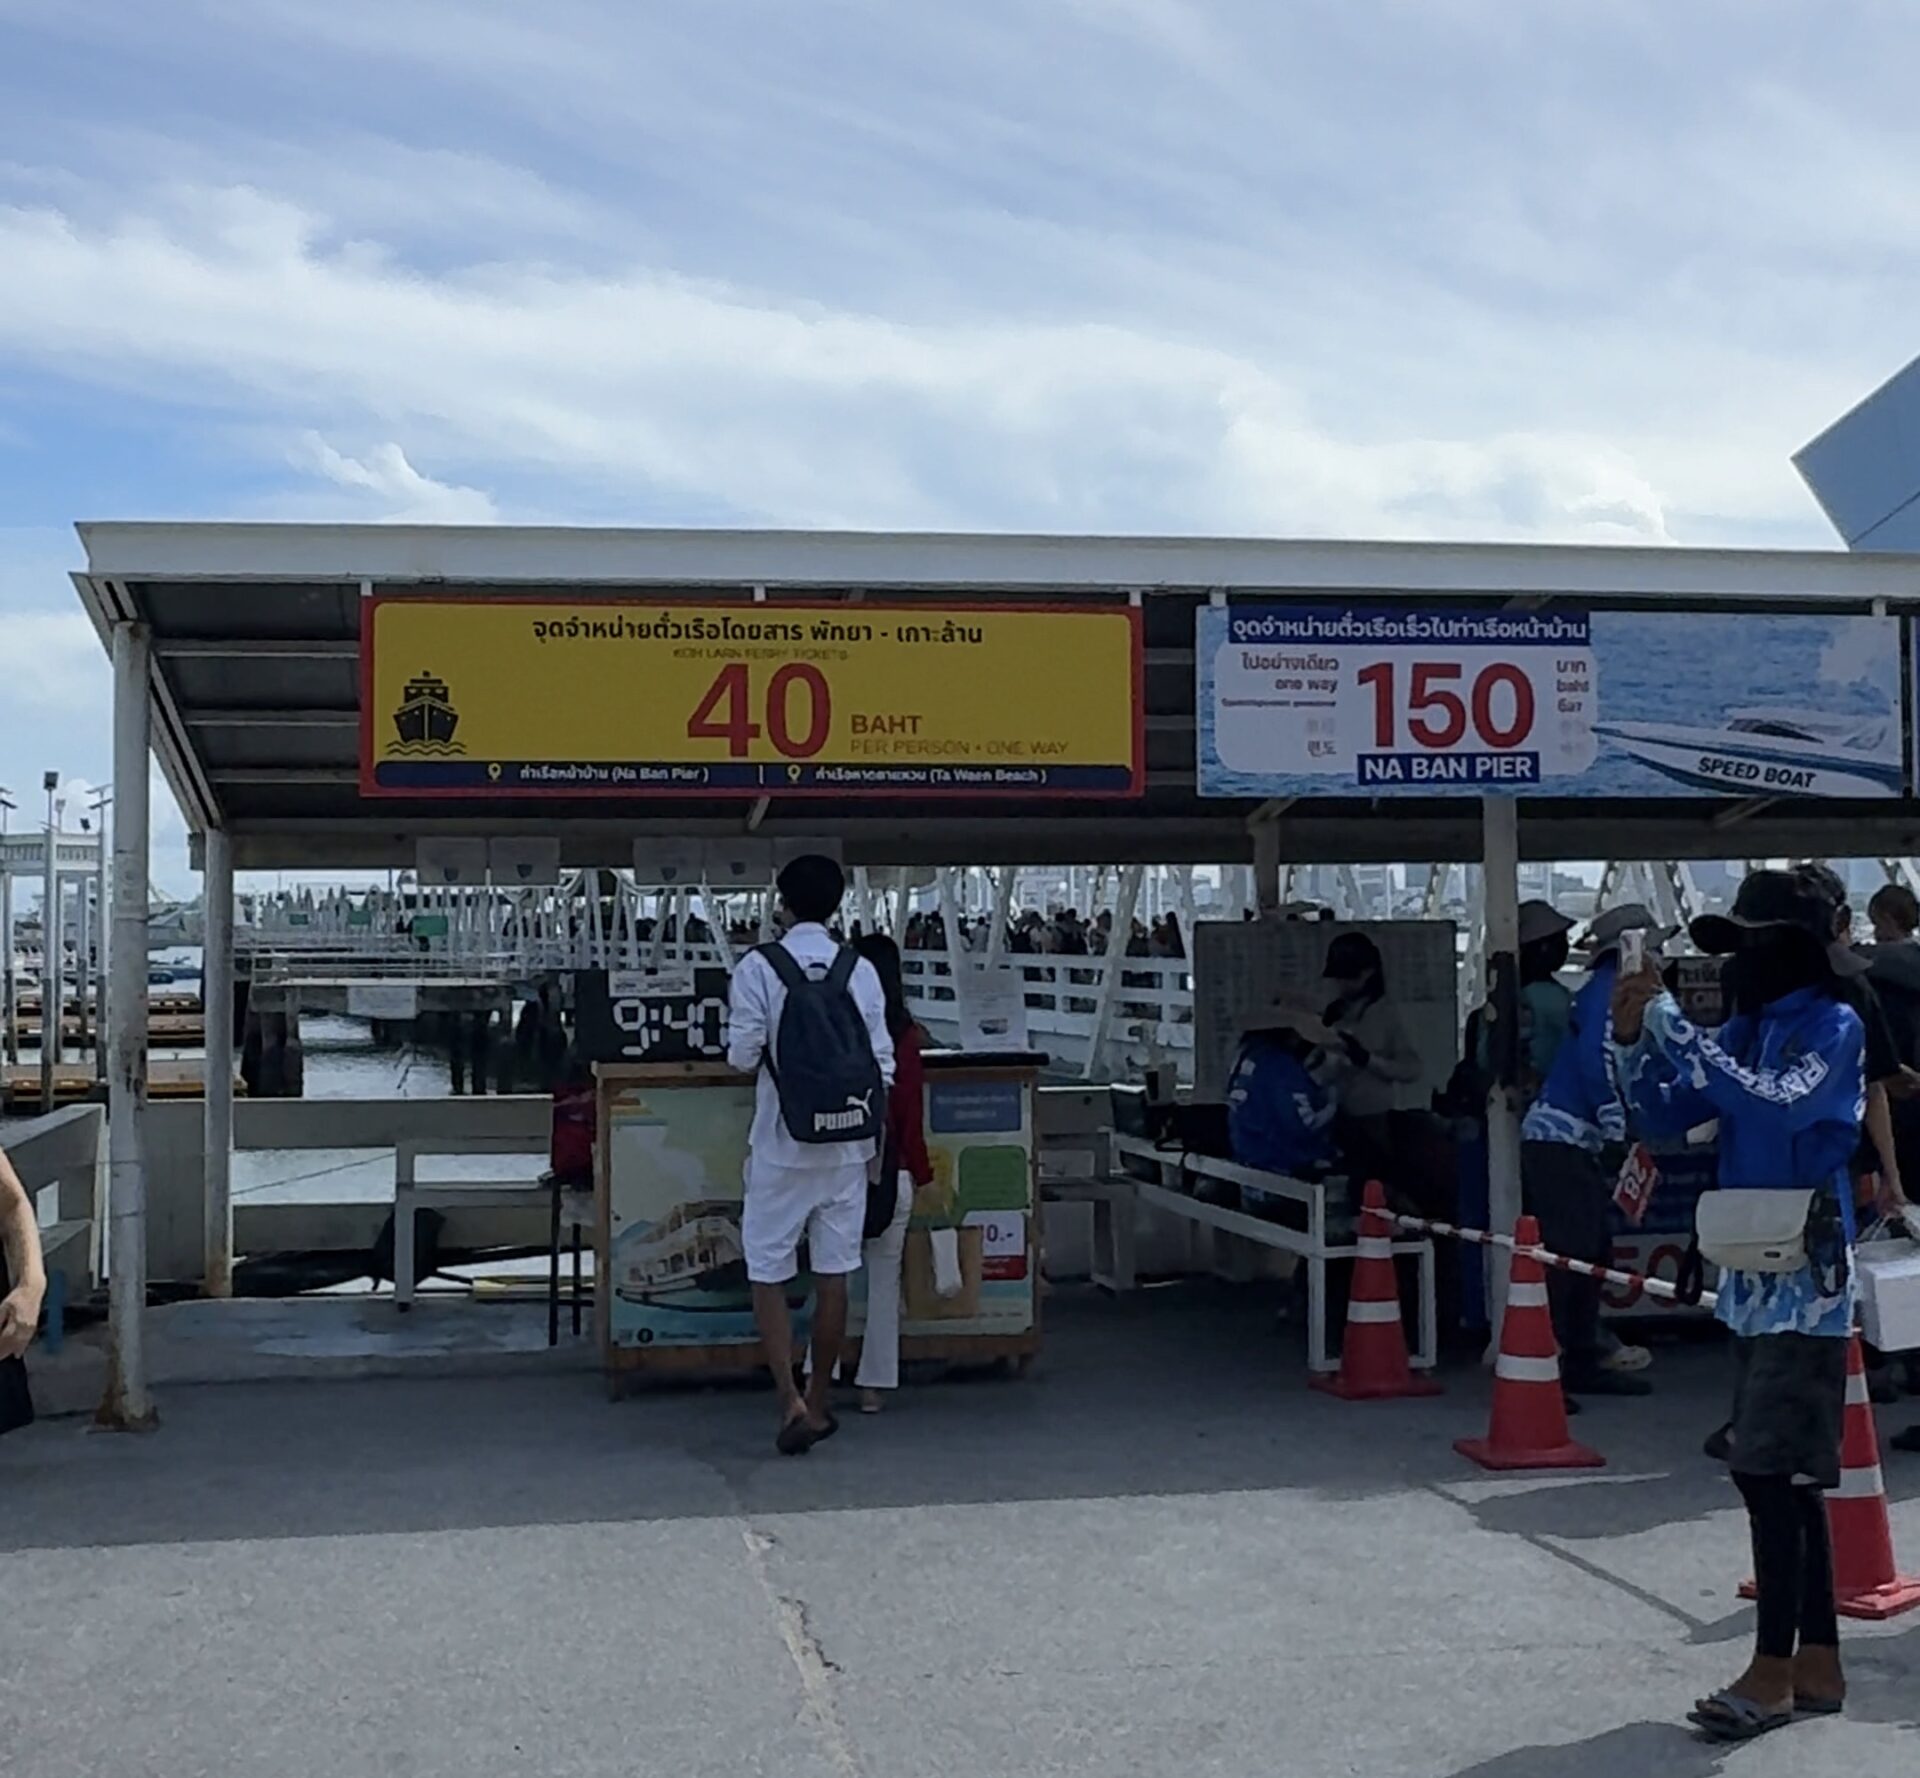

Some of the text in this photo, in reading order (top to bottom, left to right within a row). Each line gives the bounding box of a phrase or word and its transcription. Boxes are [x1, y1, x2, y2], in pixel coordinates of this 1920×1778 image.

[532, 611, 803, 642] จุดจำหน่ายตั๋วเรือโดยสาร
[811, 620, 873, 642] พัทยา
[897, 621, 983, 643] เกาะล้าน
[1241, 651, 1340, 671] ไปอย่างเดียว
[1275, 679, 1338, 694] one way
[1556, 679, 1590, 693] baht
[687, 662, 831, 759] 40
[1357, 662, 1535, 749] 150
[851, 714, 922, 735] BAHT
[850, 738, 1068, 756] PER PERSON ONE WAY
[639, 767, 669, 780] Ban
[671, 767, 699, 780] Pier
[995, 768, 1038, 782] Beach
[1365, 756, 1532, 780] NA BAN PIER
[1698, 756, 1817, 789] SPEED BOAT
[613, 998, 729, 1056] 9:40
[814, 1109, 864, 1133] PUMA
[983, 1224, 1014, 1243] 0.-
